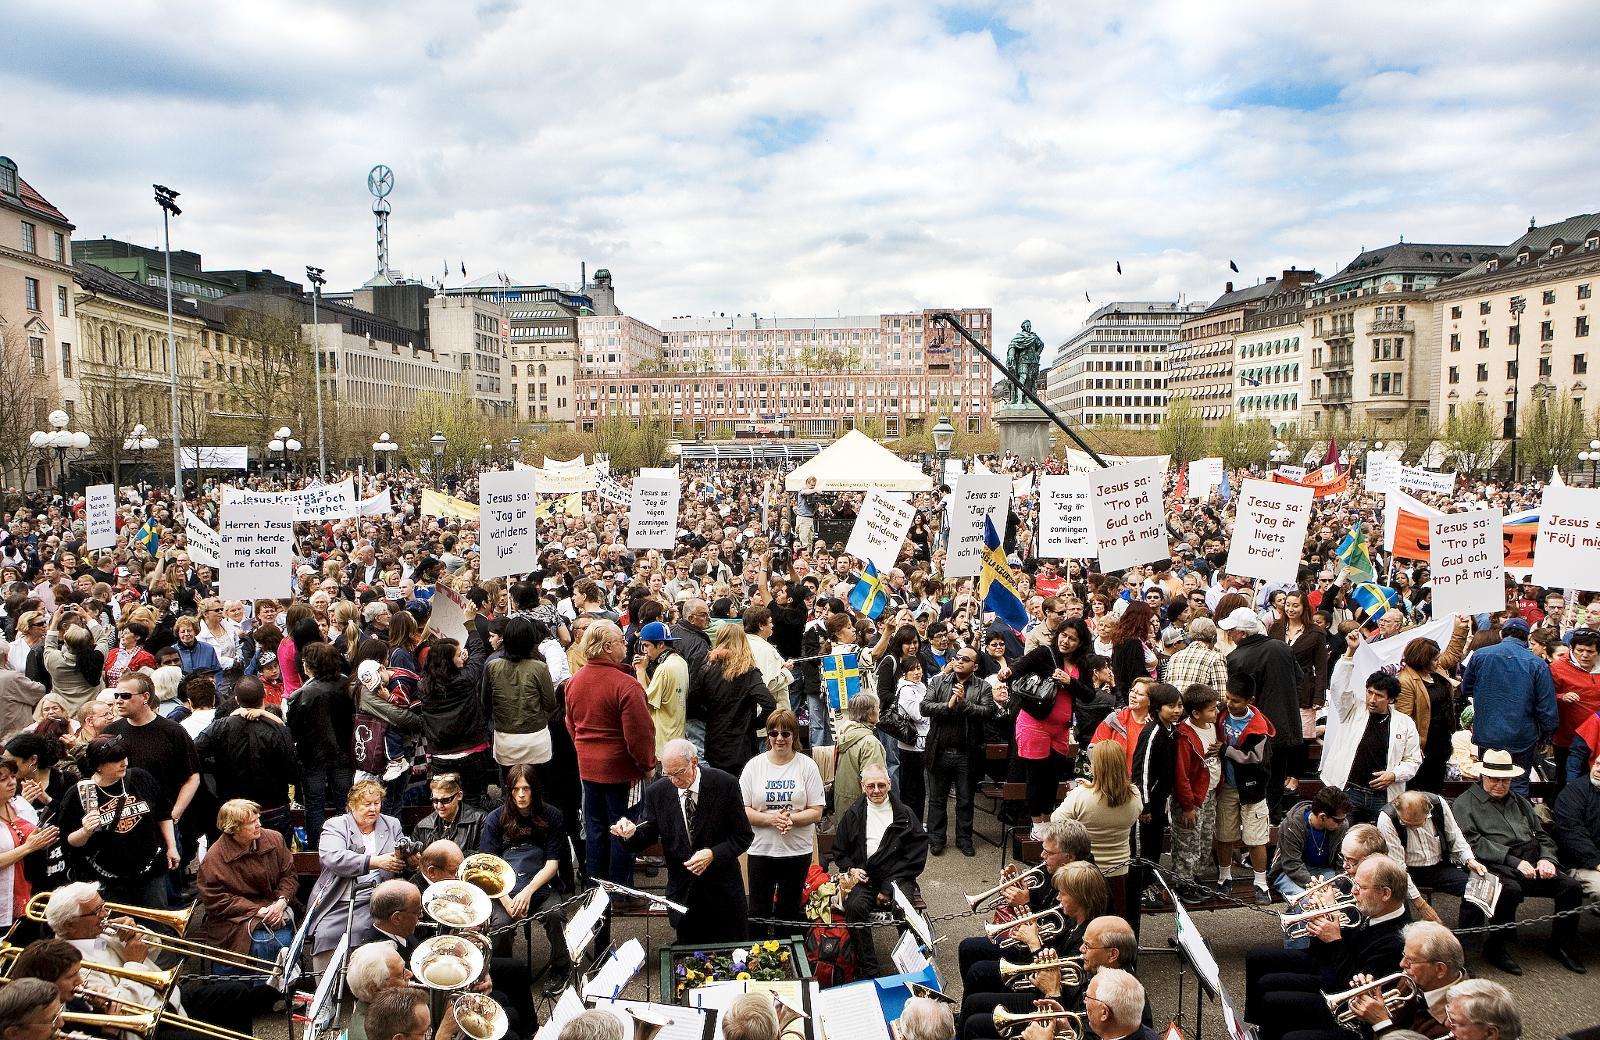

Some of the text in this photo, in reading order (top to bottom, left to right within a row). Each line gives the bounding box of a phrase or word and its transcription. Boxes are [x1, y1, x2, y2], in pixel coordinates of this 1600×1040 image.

[1096, 476, 1151, 496] Jesus sa:
[243, 494, 272, 505] Jesus
[326, 494, 346, 502] och
[486, 492, 530, 504] Jesus sa:
[966, 490, 986, 500] Jesus
[1050, 490, 1072, 498] Jesus
[1104, 490, 1149, 510] "Tro på
[642, 499, 658, 508] "Jag
[872, 494, 910, 519] Jesus sa:
[1054, 502, 1072, 512] "Jag
[1248, 496, 1303, 512] Jesus sa:
[304, 504, 347, 516] evighet.
[491, 508, 526, 522] "Jag är
[646, 508, 664, 517] vägen
[968, 505, 996, 516] "Jag är
[638, 519, 668, 528] sanningen
[874, 507, 902, 528] "Jag är
[1060, 514, 1082, 524] vägen
[1106, 510, 1152, 530] Gud och
[1251, 512, 1296, 528] "Jag är
[1549, 514, 1590, 528] Jesus
[224, 520, 292, 529] Herren Jesus
[972, 520, 986, 530] väg
[1050, 526, 1088, 534] sanningen
[1436, 518, 1490, 536] Jesus sa:
[490, 526, 528, 539] världens
[866, 520, 898, 542] världens
[1098, 523, 1166, 549] tro på mig".
[1254, 528, 1286, 543] livets
[222, 534, 232, 542] är
[236, 534, 254, 542] min
[960, 533, 984, 542] sannin
[1442, 538, 1468, 549] "Tro
[1472, 532, 1486, 548] på
[1544, 530, 1576, 548] "Följ
[234, 546, 276, 556] mig skall
[958, 548, 983, 556] och liv
[1248, 544, 1283, 560] bröd".
[226, 560, 283, 568] inte fattas.
[1442, 550, 1488, 567] Gud och
[1432, 565, 1499, 585] tro på mig".
[765, 780, 796, 790] JESUS
[766, 791, 794, 802] IS MY
